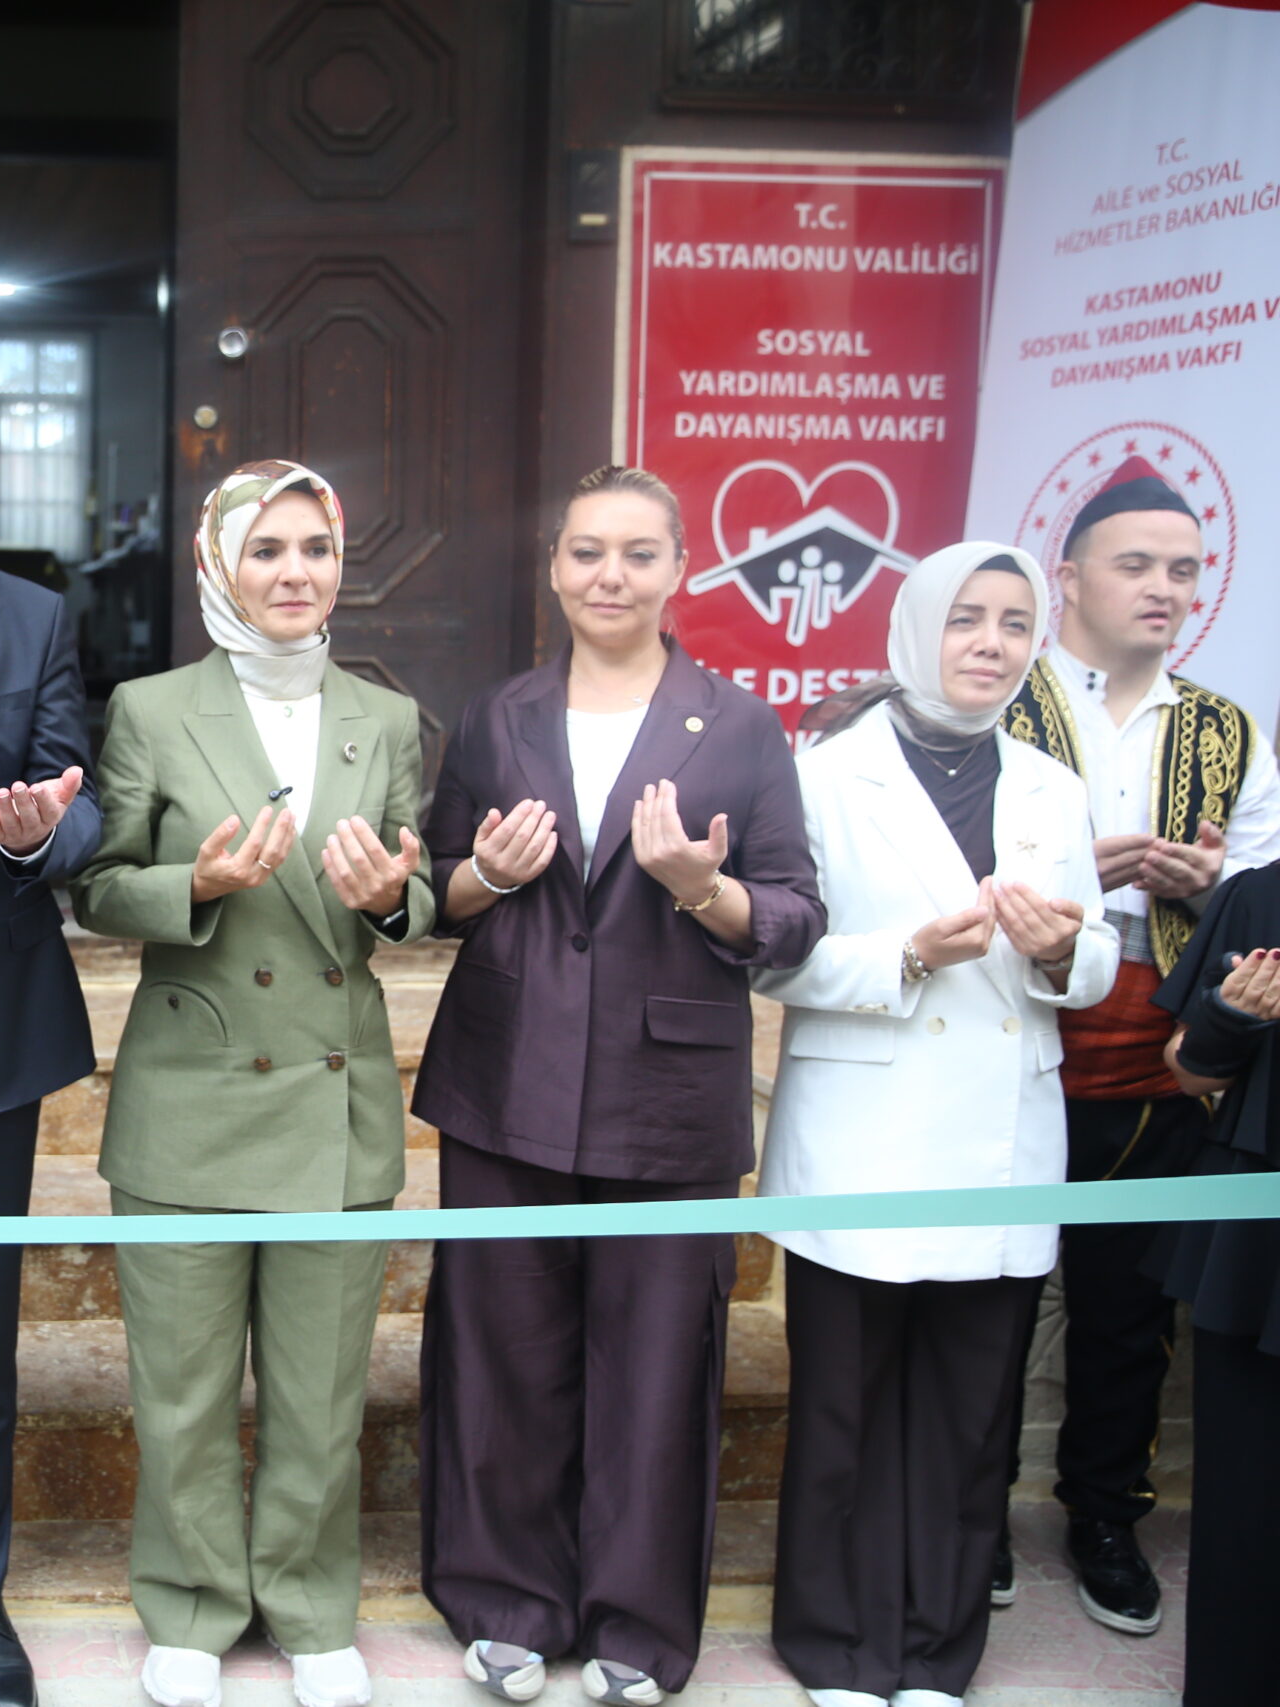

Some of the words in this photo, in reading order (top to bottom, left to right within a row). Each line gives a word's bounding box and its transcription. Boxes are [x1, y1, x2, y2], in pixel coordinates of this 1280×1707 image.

[1156, 138, 1189, 166] T.C.
[1091, 186, 1133, 216] AİLE
[1137, 184, 1161, 205] ve
[1165, 159, 1245, 199] SOSYAL
[794, 203, 847, 230] T.C.
[1054, 212, 1161, 257] HİZMETLER
[653, 242, 847, 272] KASTAMONU
[854, 242, 979, 275] VALİLİĞİ
[1084, 270, 1223, 316] KASTAMONU
[756, 329, 872, 357] SOSYAL
[1019, 330, 1091, 361] SOSYAL
[1096, 302, 1257, 348] YARDIMLAŞMA
[1050, 352, 1170, 388] DAYANIŞMA
[1176, 341, 1243, 370] VAKFI
[679, 370, 901, 405] YARDIMLAŞMA
[907, 374, 946, 400] VE
[675, 411, 853, 446] DAYANIŞMA
[858, 416, 946, 442] VAKFI
